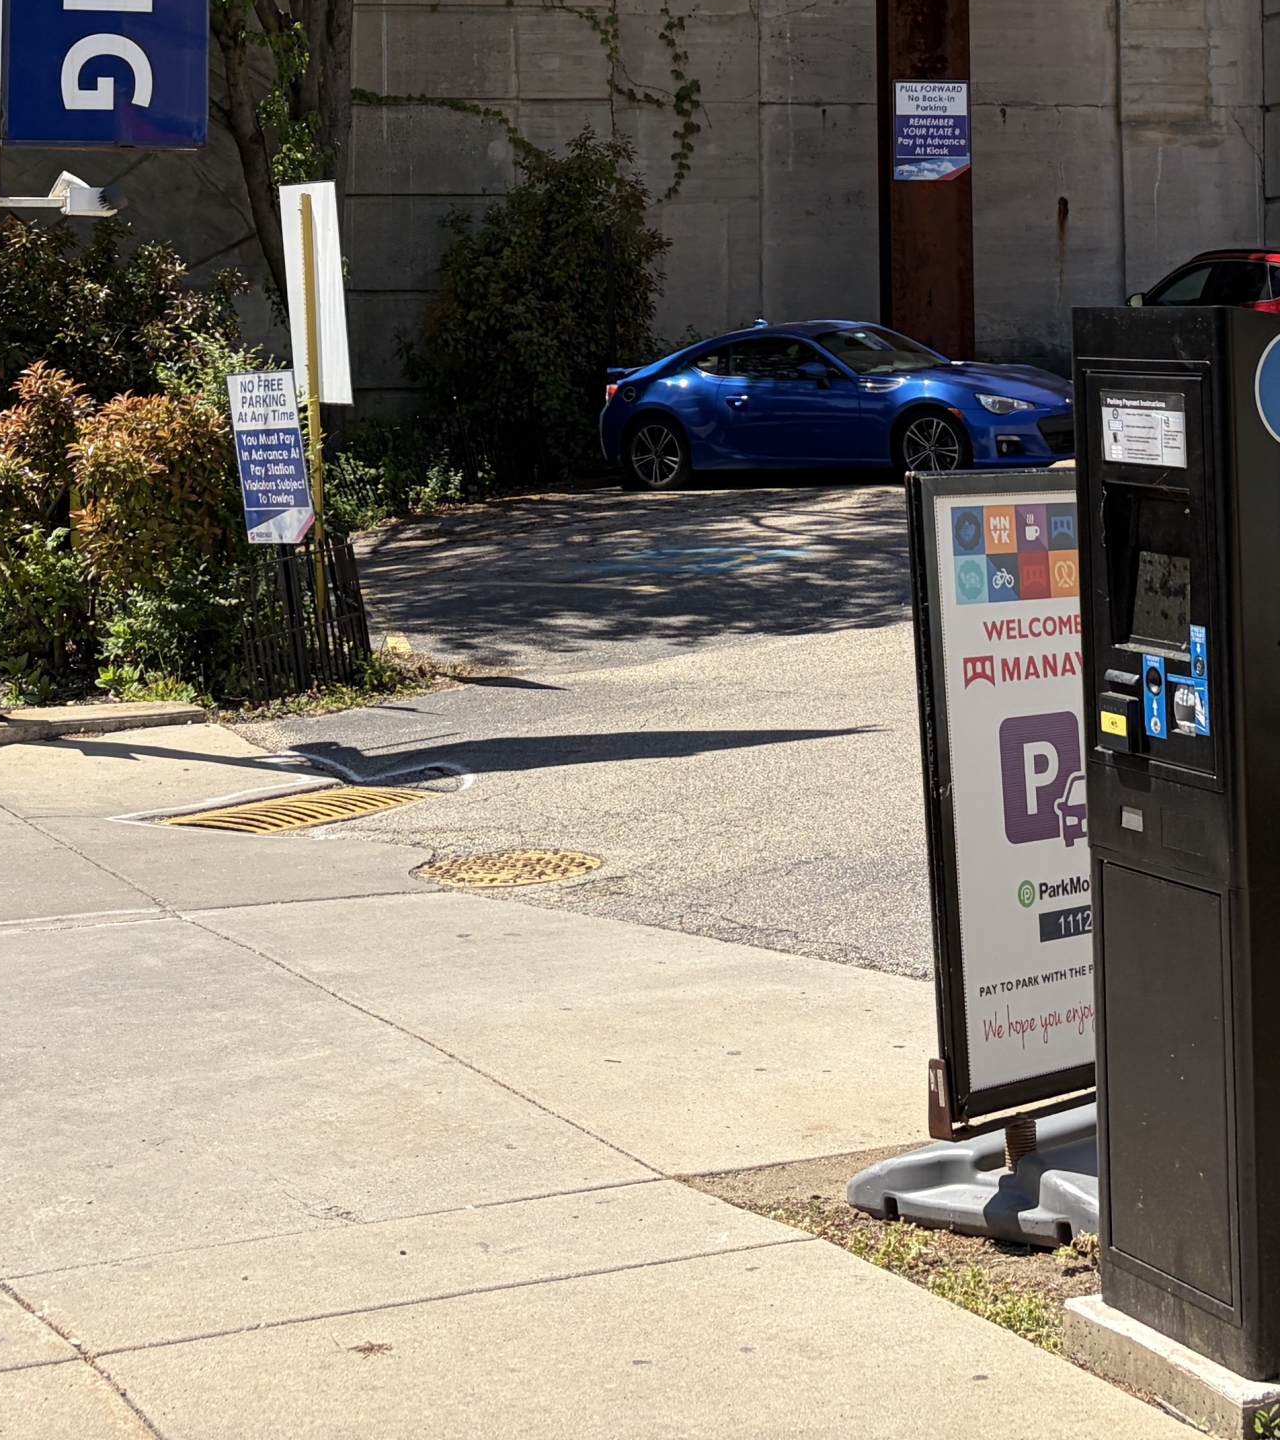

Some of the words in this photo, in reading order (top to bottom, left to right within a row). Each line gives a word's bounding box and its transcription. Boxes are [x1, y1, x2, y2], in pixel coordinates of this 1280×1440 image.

[900, 85, 919, 93] PULL
[920, 85, 962, 93] FORWARD
[915, 104, 947, 113] Parking
[909, 118, 954, 126] REMEMBER
[903, 127, 927, 135] YOUR
[929, 127, 953, 136] PLATE
[898, 137, 914, 146] Pay
[926, 137, 966, 146] Advance
[915, 147, 924, 155] At
[926, 147, 949, 155] Kiosk
[240, 380, 254, 394] NO
[257, 378, 283, 393] FREE
[241, 393, 286, 409] PARKING
[237, 411, 248, 424] At
[250, 411, 269, 426] Any
[271, 409, 295, 422] Time
[241, 434, 257, 446] You
[259, 433, 278, 445] Must
[279, 432, 295, 446] Pay
[241, 449, 250, 460] In
[251, 448, 289, 460] Advance
[290, 447, 300, 459] At
[250, 464, 265, 478] Pay
[267, 463, 295, 475] Station
[244, 479, 276, 491] Violators
[277, 478, 305, 491] Subject
[258, 493, 268, 504] To
[268, 492, 295, 506] Towing
[989, 515, 1010, 530] MN
[990, 530, 1011, 545] YK
[983, 613, 1082, 642] WELCOME
[1023, 740, 1059, 815] P
[1038, 875, 1091, 900] ParkMo
[1058, 910, 1093, 935] 1112
[979, 983, 998, 997] PAY
[1000, 980, 1014, 992] TO
[1015, 975, 1040, 990] PARK
[1041, 969, 1067, 985] WITH
[1069, 965, 1087, 979] THE
[983, 1010, 1005, 1042] We
[1006, 1004, 1038, 1050] hope
[1040, 1010, 1063, 1044] you
